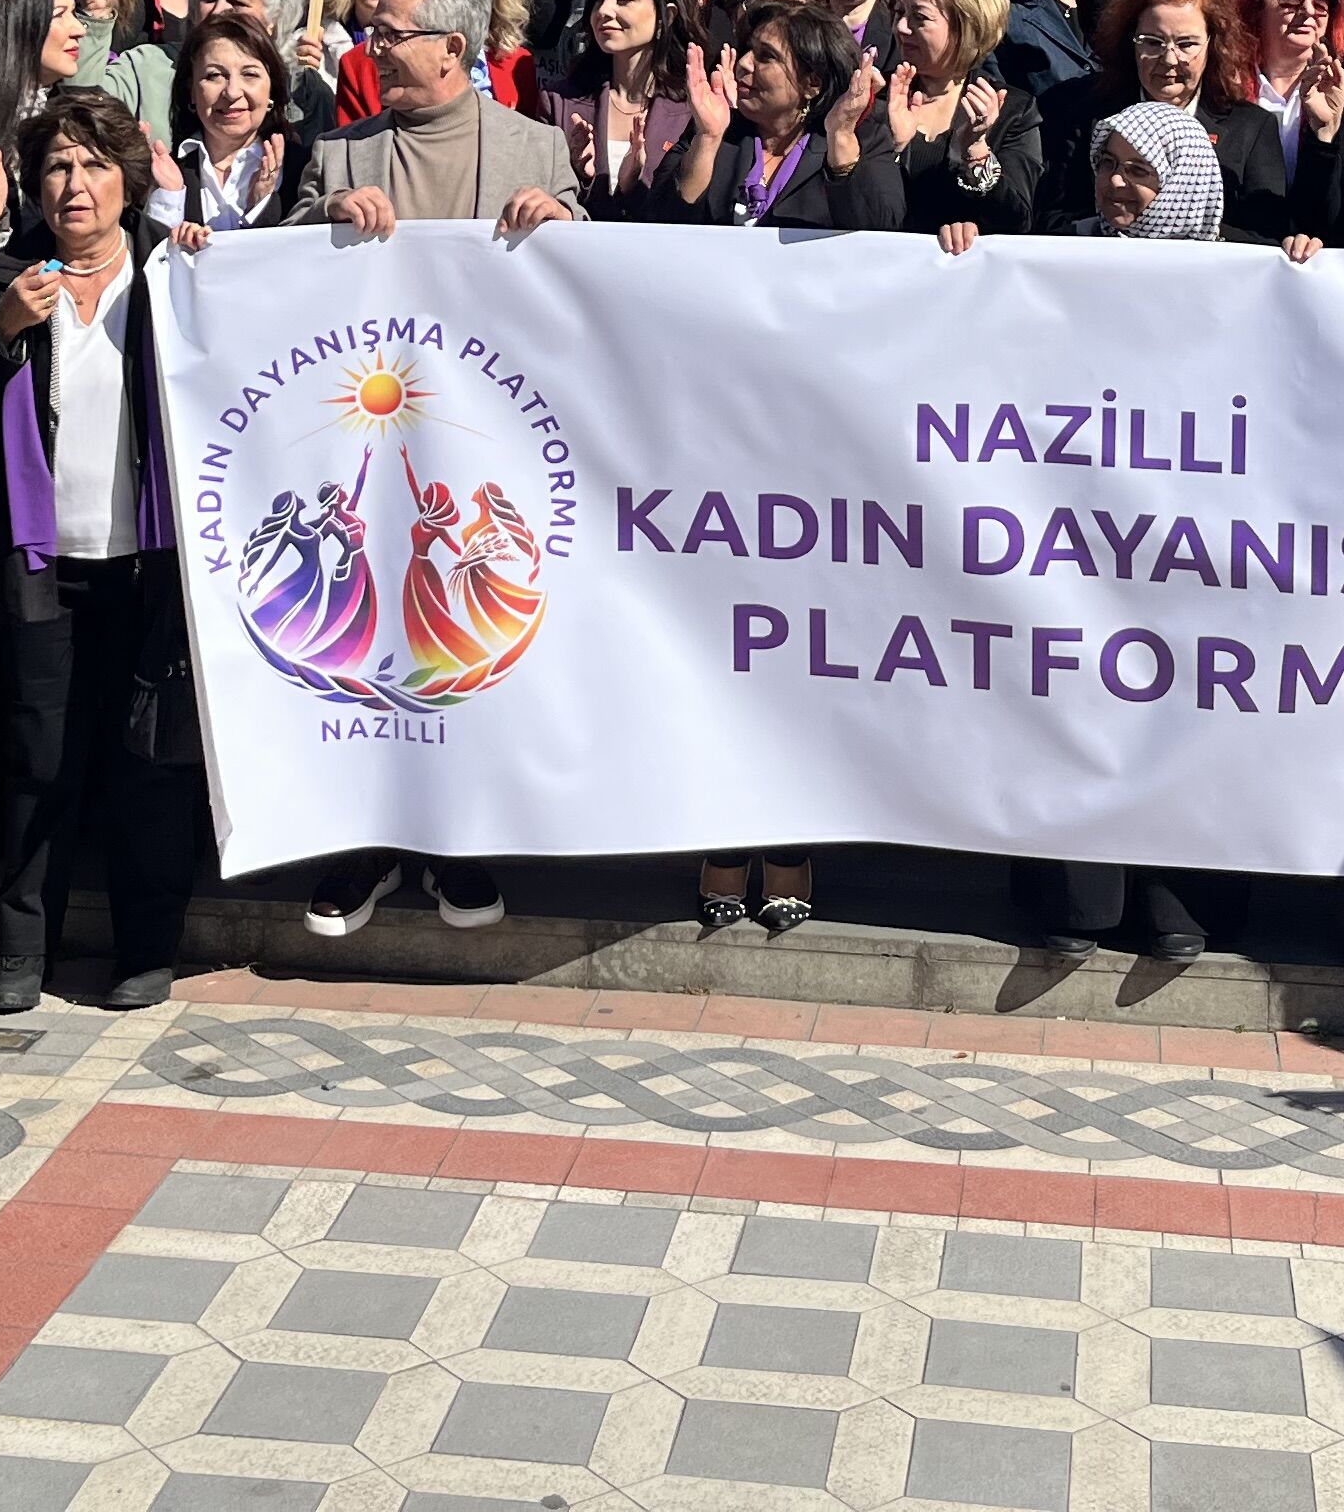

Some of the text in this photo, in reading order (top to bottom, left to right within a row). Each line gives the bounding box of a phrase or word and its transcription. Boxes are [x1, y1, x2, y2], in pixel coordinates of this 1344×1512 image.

[196, 317, 577, 575] KADIN DAYANIŞMA PLATFORMU
[915, 388, 1249, 476] NAZİLLİ
[614, 485, 925, 571] KADIN
[321, 711, 446, 745] NAZİLLİ
